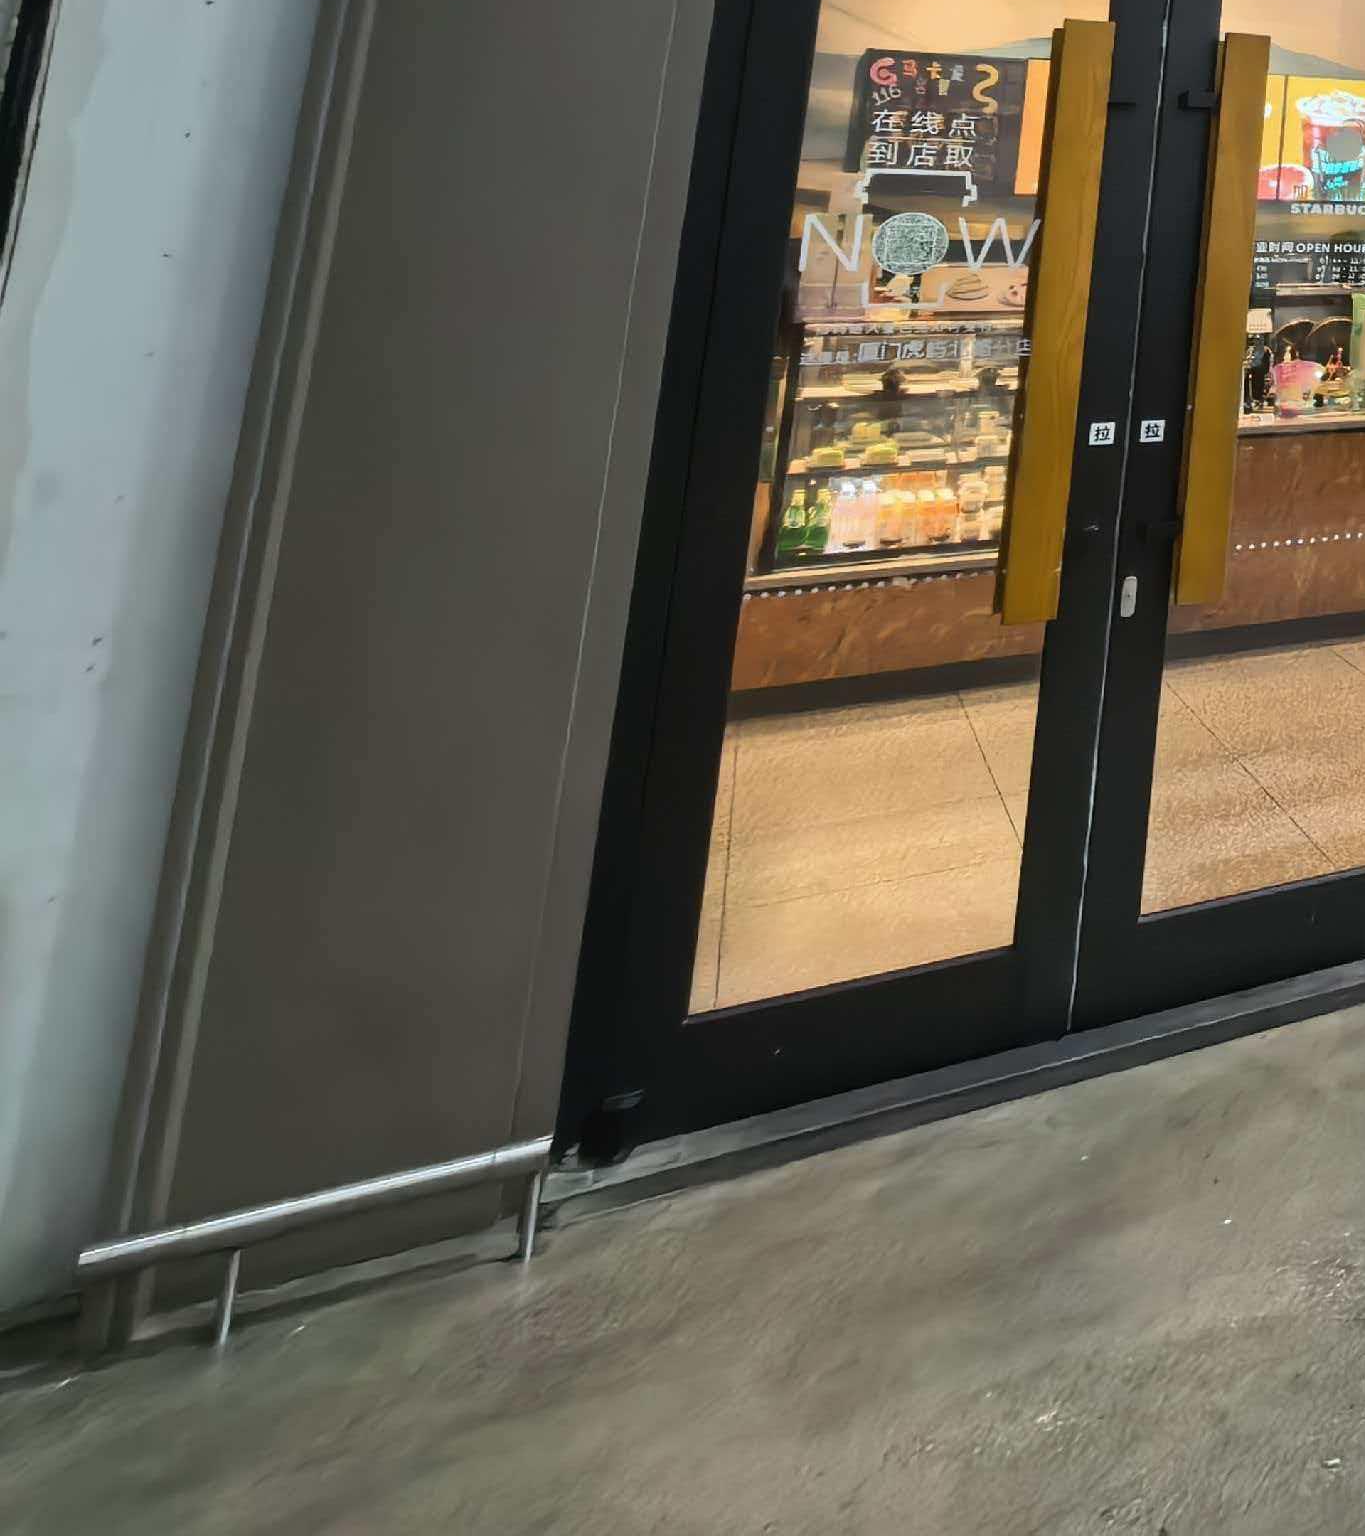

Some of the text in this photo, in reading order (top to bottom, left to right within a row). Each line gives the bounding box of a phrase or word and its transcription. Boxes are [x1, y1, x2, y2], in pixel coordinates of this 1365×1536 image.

[872, 109, 981, 136] 在线点
[867, 140, 975, 168] 到店取
[1296, 243, 1330, 253] OPEN
[1094, 424, 1112, 442] 拉
[1145, 423, 1161, 439] 拉
